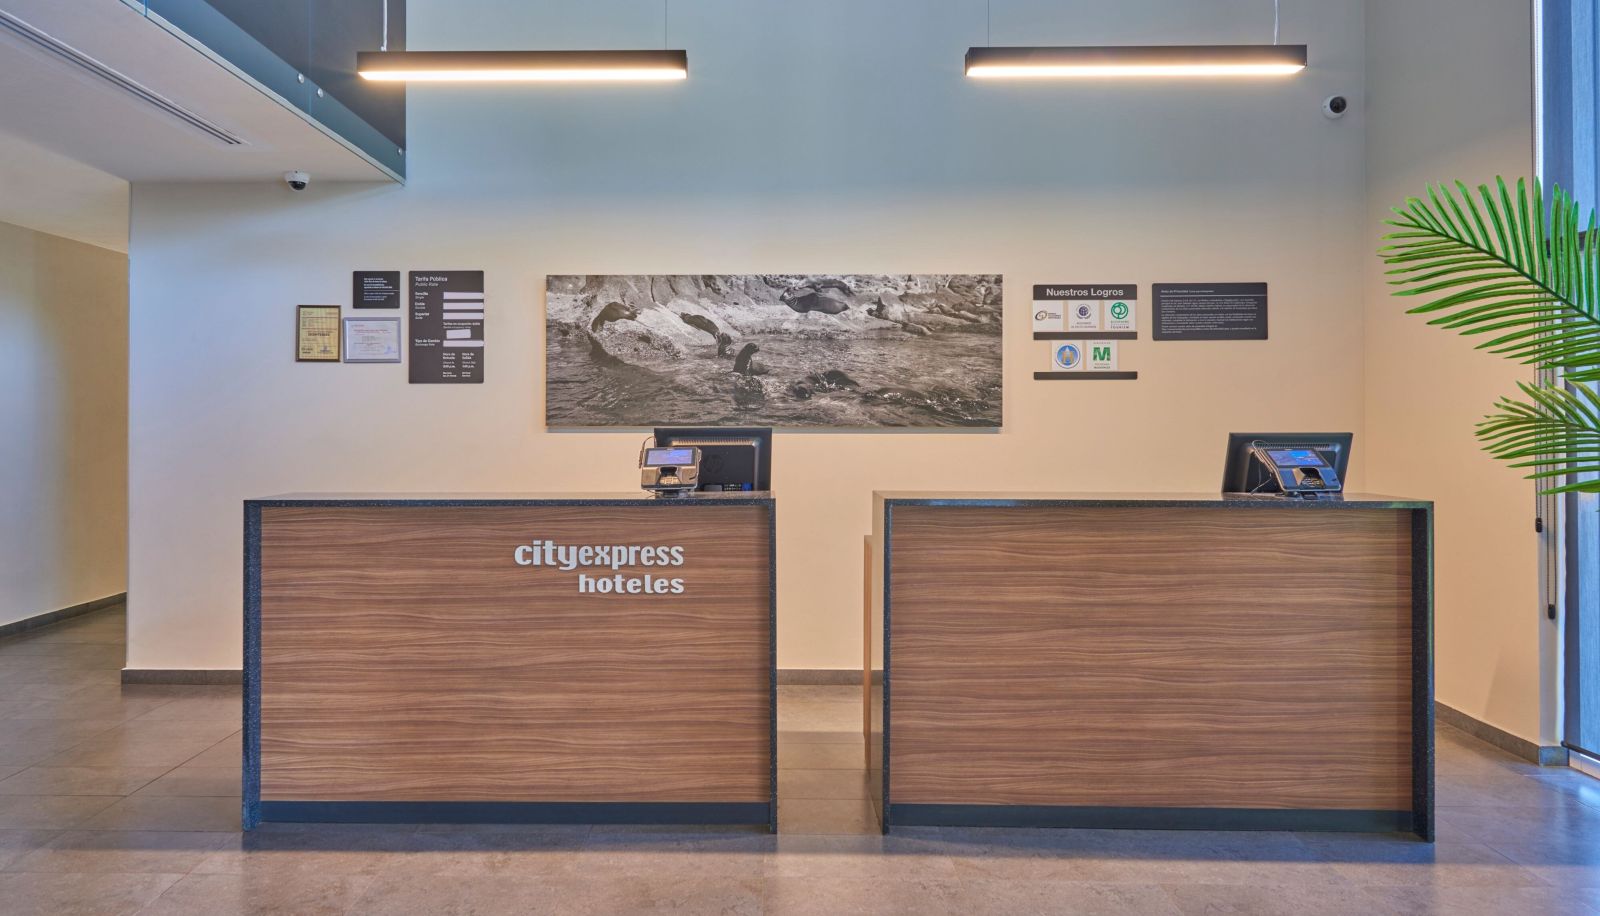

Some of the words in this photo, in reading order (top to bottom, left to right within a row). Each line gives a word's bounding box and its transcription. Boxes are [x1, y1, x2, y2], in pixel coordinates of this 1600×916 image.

[1046, 288, 1089, 296] Nuestros
[1090, 288, 1124, 298] Logros
[1093, 347, 1111, 361] M
[514, 540, 684, 571] cityexpress
[578, 574, 685, 594] hoteles
